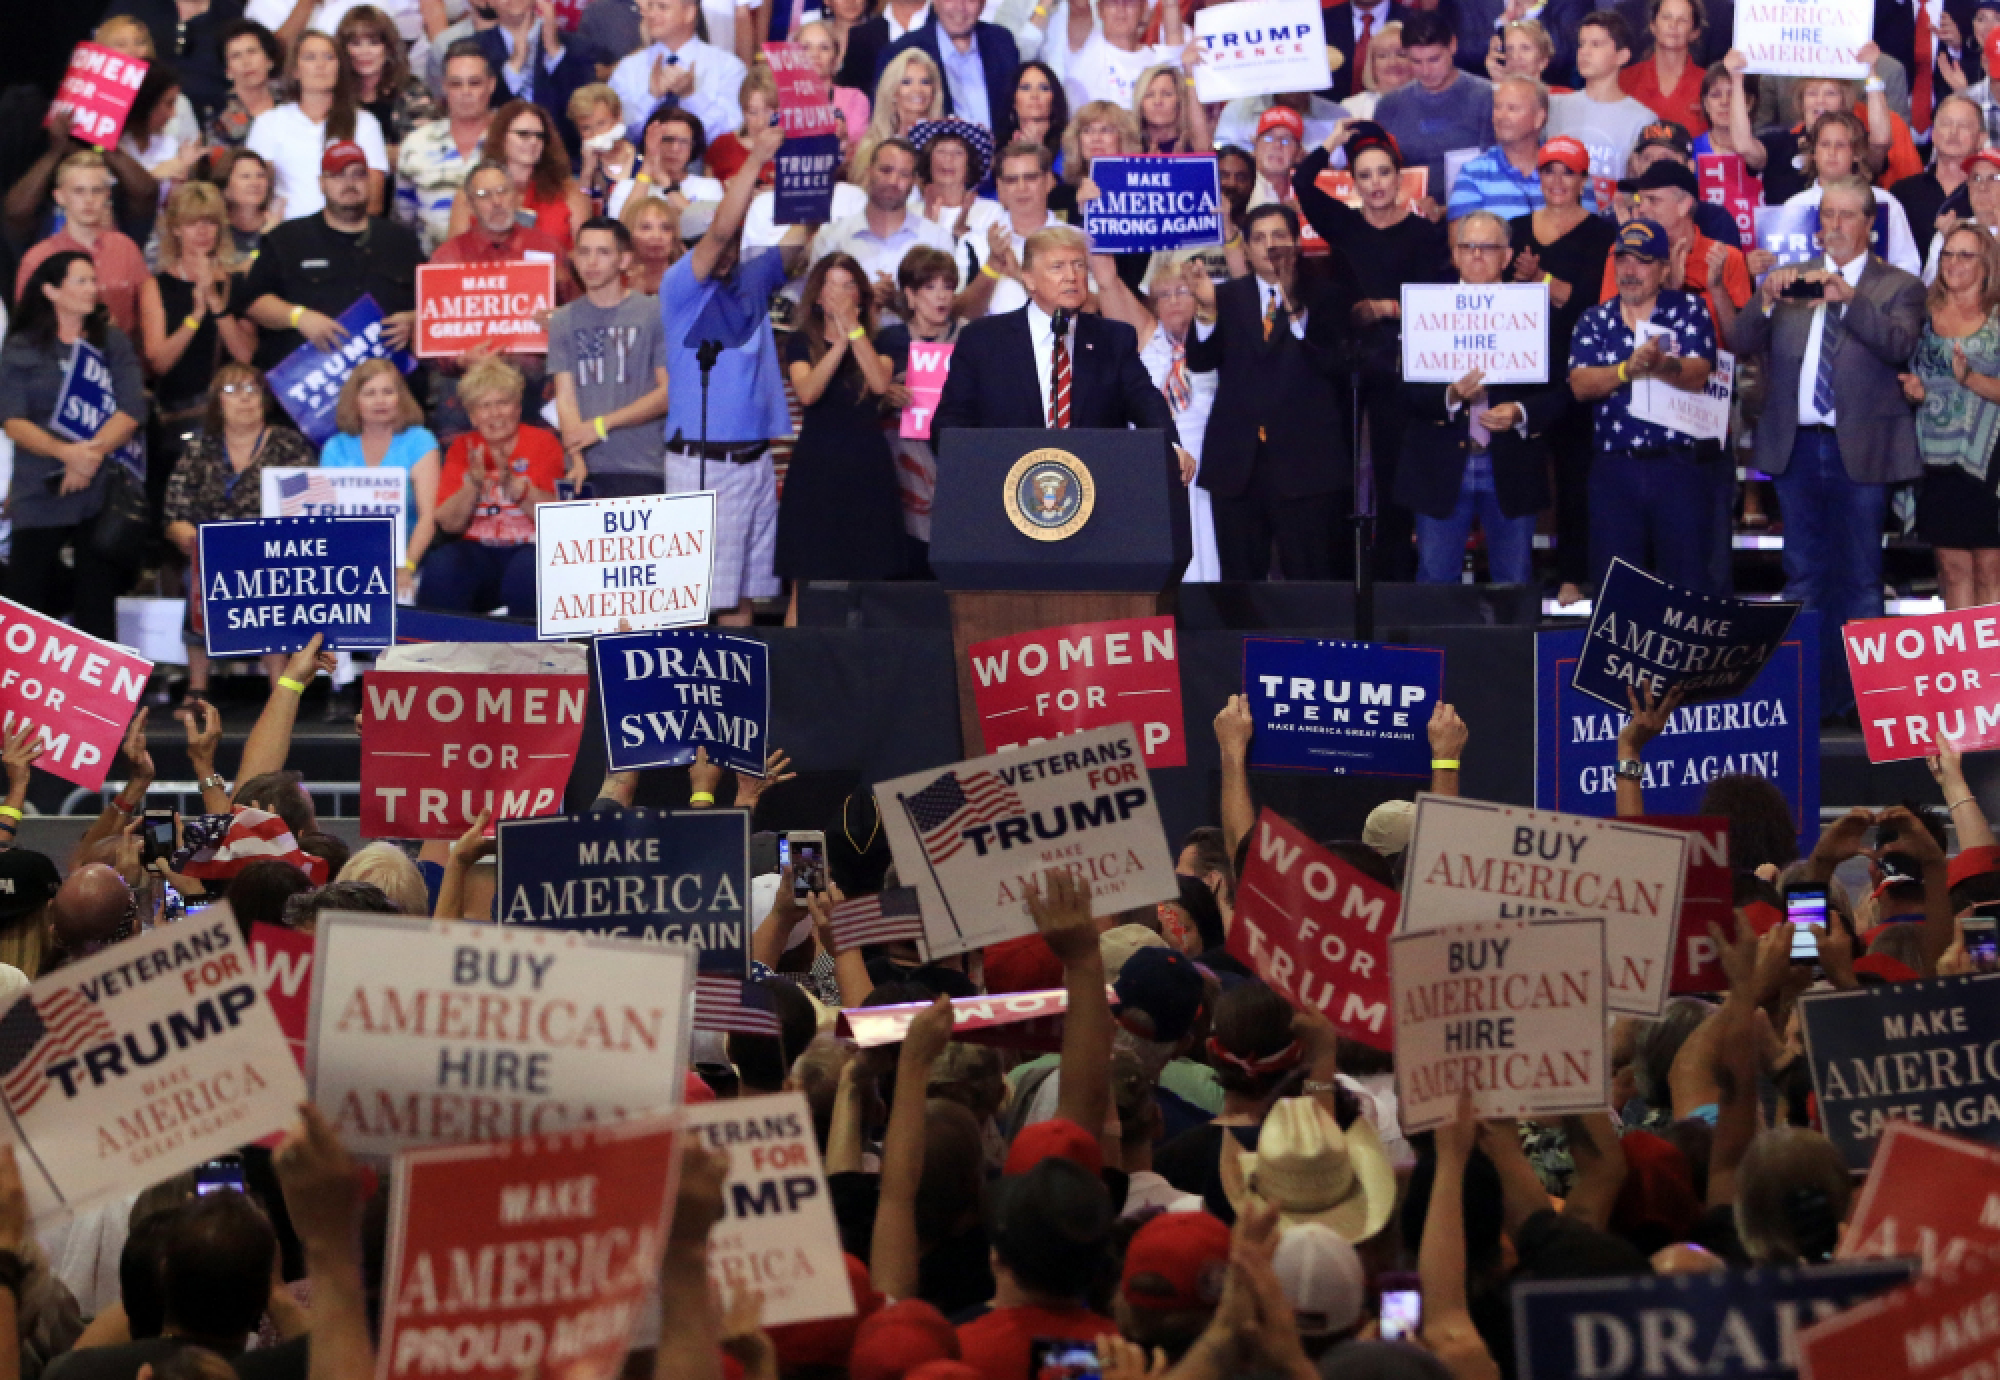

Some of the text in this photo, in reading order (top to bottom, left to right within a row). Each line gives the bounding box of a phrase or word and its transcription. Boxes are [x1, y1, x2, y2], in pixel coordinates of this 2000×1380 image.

[1745, 4, 1861, 26] AMERICAN
[1204, 23, 1312, 50] TRUMP
[1214, 41, 1304, 63] PENCE
[1781, 26, 1822, 44] HIRE
[779, 154, 834, 175] TRUMP
[1126, 171, 1172, 188] MAKE
[1089, 189, 1217, 215] AMERICA
[1088, 215, 1219, 237] STRONG AGAIN
[461, 276, 508, 291] MAKE
[421, 293, 549, 320] AMERICA
[1455, 294, 1495, 311] BUY
[429, 318, 541, 338] GREAT AGAIN
[1413, 312, 1538, 332] AMERICAN
[1452, 333, 1497, 351] HIRE
[286, 320, 382, 403] TRUMP
[1414, 350, 1538, 371] AMERICAN
[328, 476, 401, 489] VETERANS
[373, 490, 401, 501] FOR
[603, 508, 653, 534] BUY
[263, 538, 328, 558] MAKE
[550, 529, 704, 566] AMERICAN
[207, 565, 390, 601] AMERICA
[602, 563, 657, 589] HIRE
[227, 603, 371, 629] SAFE AGAIN
[550, 584, 702, 621] AMERICAN
[1662, 606, 1733, 637] MAKE
[0, 614, 147, 703] OMEN
[972, 628, 1175, 687] WOMEN
[1594, 611, 1767, 673] AMERICA
[621, 646, 752, 684] DRAIN
[1603, 653, 1667, 697] SAFE
[1913, 668, 1982, 697] FOR
[0, 667, 66, 713] FOR
[367, 686, 585, 725] WOMEN
[673, 683, 723, 706] THE
[1035, 686, 1107, 716] FOR
[1259, 673, 1427, 708] TRUMP
[620, 710, 759, 752] SWAMP
[1267, 721, 1295, 732] MAKE
[1297, 724, 1343, 735] AMERICA
[1344, 727, 1377, 738] GREAT
[1273, 702, 1409, 727] PENCE
[1571, 698, 1789, 743] MAK AMERICA
[442, 744, 519, 769] FOR
[999, 738, 1133, 787] VETERANS
[1579, 750, 1780, 794] GRAT AGAIN!
[1087, 763, 1140, 791] FOR
[375, 787, 555, 824] TRUMP
[961, 787, 1148, 857] TRUMP
[578, 837, 661, 866] MAKE
[1041, 843, 1083, 863] MAKE
[1512, 825, 1589, 865] BUY
[1259, 821, 1387, 933] WOM
[1423, 850, 1665, 918] AMERICAN
[504, 871, 743, 924] AMERICA
[642, 922, 742, 951] AGAIN
[1297, 916, 1376, 980] FOR
[77, 921, 233, 1004] VETERANS
[181, 951, 242, 996] FOR
[452, 945, 556, 991] BUY
[1447, 938, 1511, 974] BUY
[1402, 970, 1590, 1026] AMERICAN
[336, 986, 665, 1053] AMERICAN
[1445, 1016, 1516, 1054] HIRE
[1882, 1006, 1969, 1041] MAKE
[45, 982, 257, 1098] TRUMP
[435, 1046, 552, 1095] HIRE
[1408, 1049, 1593, 1107] AMERICAN
[95, 1061, 268, 1160] AMERICA
[332, 1089, 632, 1143] AMERIC
[751, 1143, 810, 1172] FOR
[500, 1174, 599, 1228] MAKE
[718, 1248, 816, 1288] RICA
[394, 1319, 546, 1376] PROUD
[1571, 1299, 1840, 1378] DRAI
